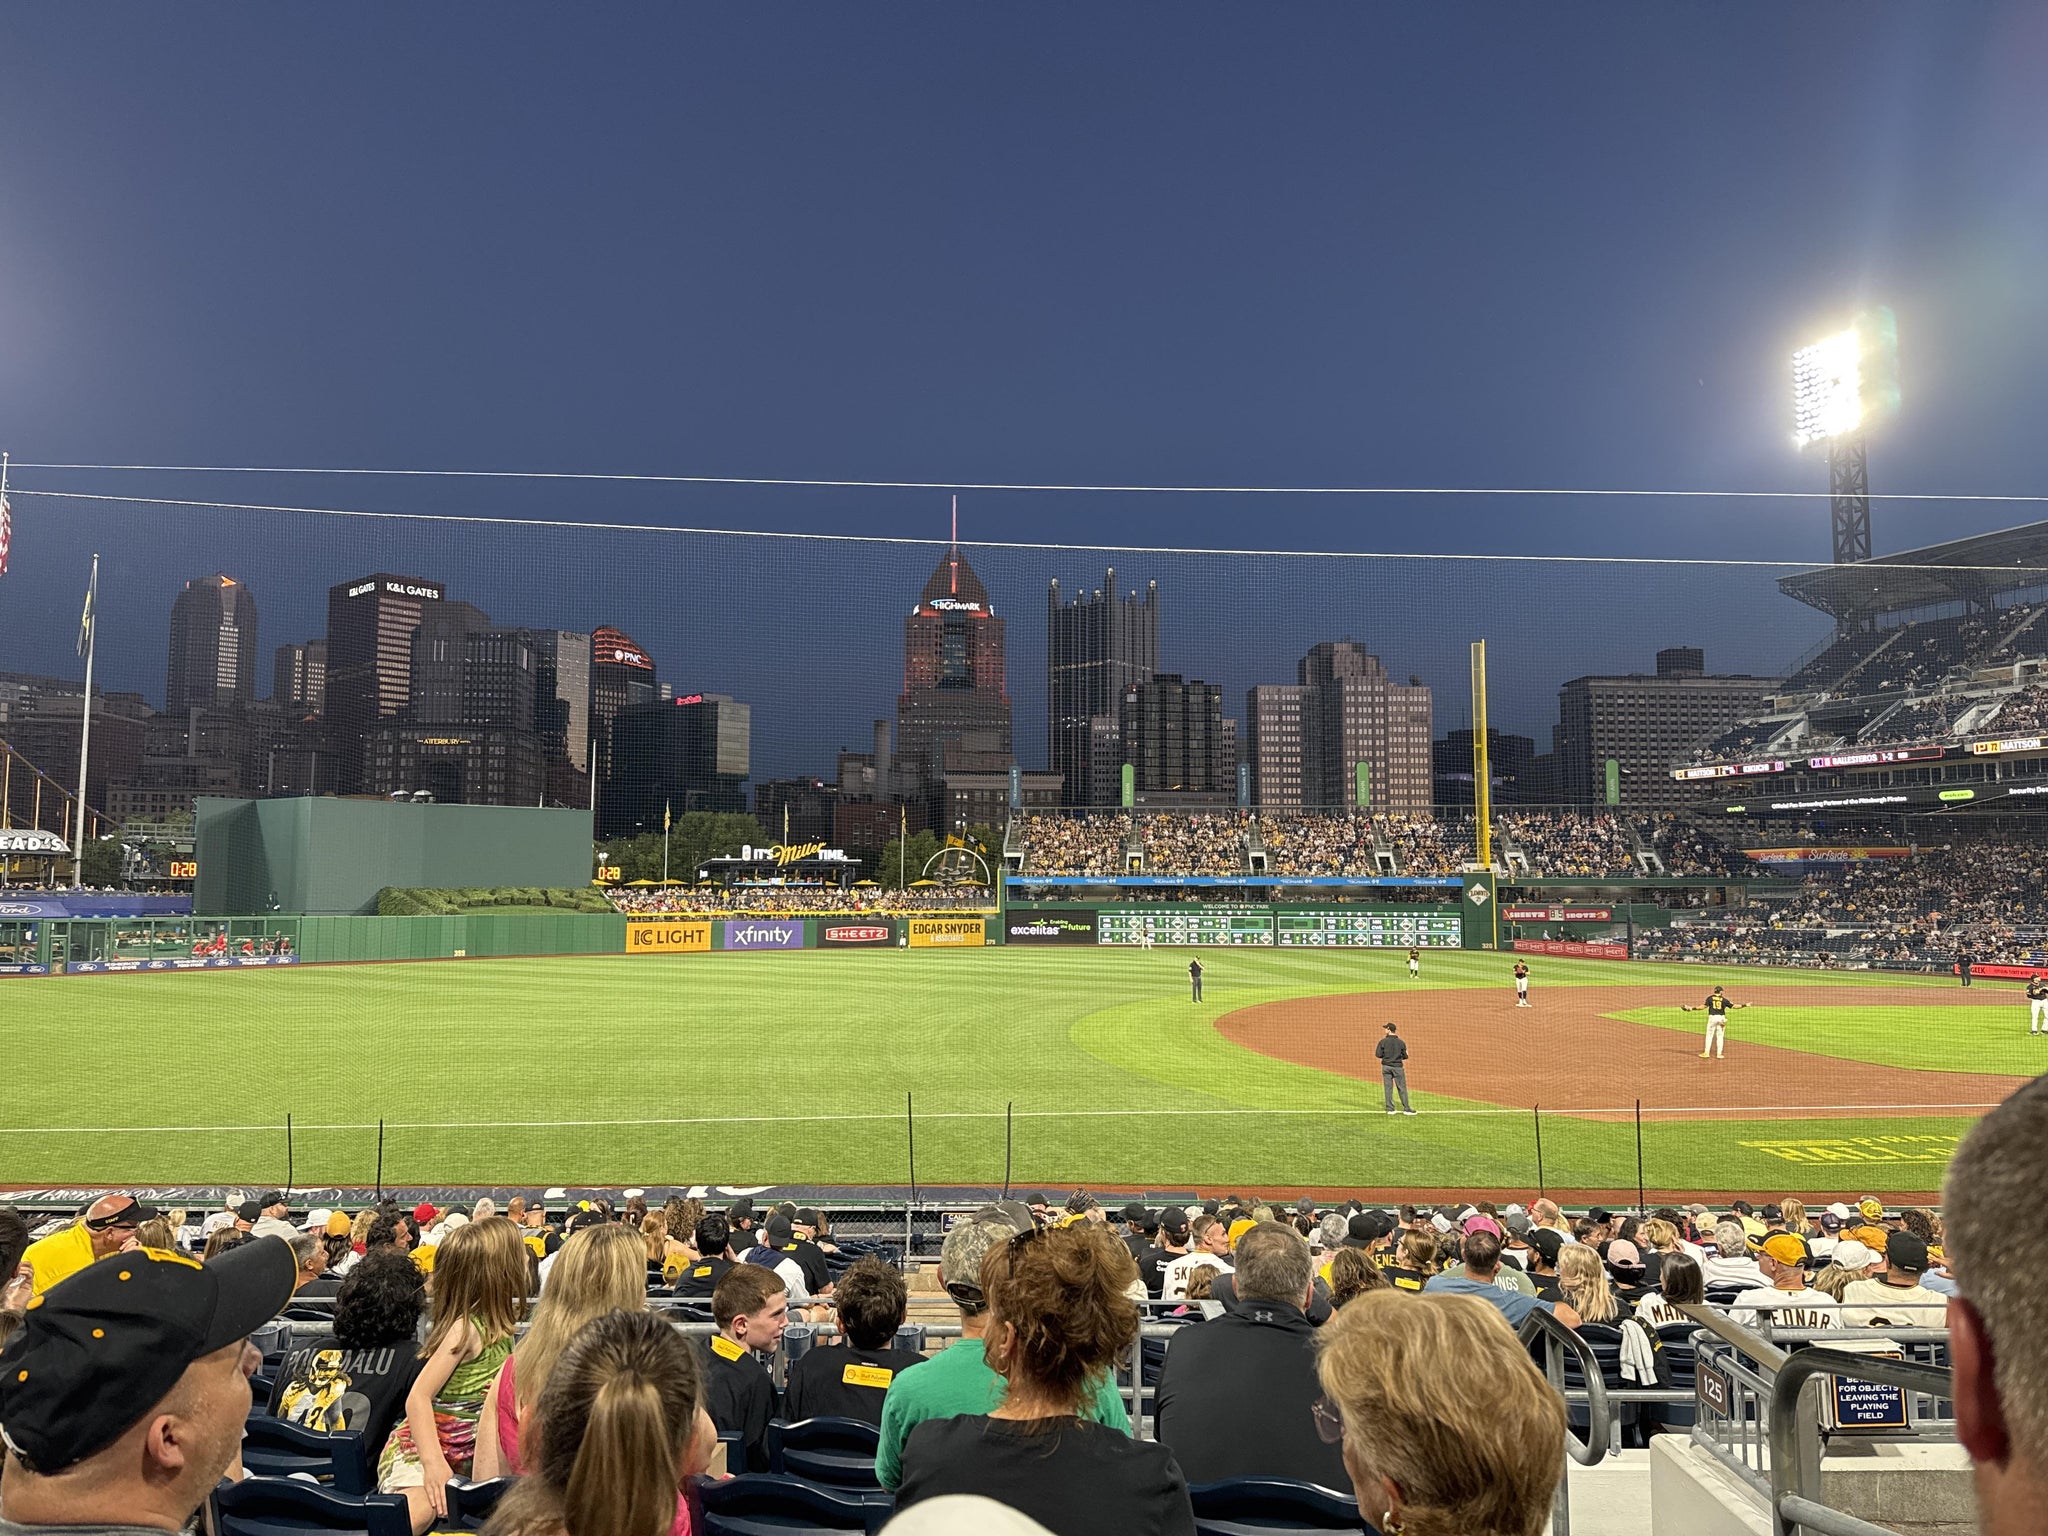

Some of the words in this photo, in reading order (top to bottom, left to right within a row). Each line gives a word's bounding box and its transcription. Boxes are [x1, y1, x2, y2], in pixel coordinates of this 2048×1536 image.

[358, 582, 375, 594] GATES
[386, 582, 405, 593] K&L
[406, 586, 439, 599] GATES
[624, 652, 642, 664] PNC
[2000, 739, 2041, 750] MATTSON
[2008, 786, 2036, 795] Security
[771, 841, 826, 867] Miller
[1808, 849, 1849, 861] Surfside
[170, 862, 197, 877] 0:28
[598, 867, 620, 880] 0:28
[830, 930, 884, 938] SHEETZ
[914, 924, 943, 934] EDGAR
[944, 923, 981, 934] SNYDER
[1010, 926, 1060, 935] excelitas
[634, 930, 653, 945] IC
[656, 930, 704, 944] LIGHT
[734, 926, 793, 945] xfinity
[1703, 1374, 1722, 1403] 125
[1840, 1393, 1878, 1402] LEAVING
[1879, 1393, 1899, 1401] THE
[1850, 1402, 1889, 1411] PLAYING
[1857, 1411, 1884, 1420] FIELD
